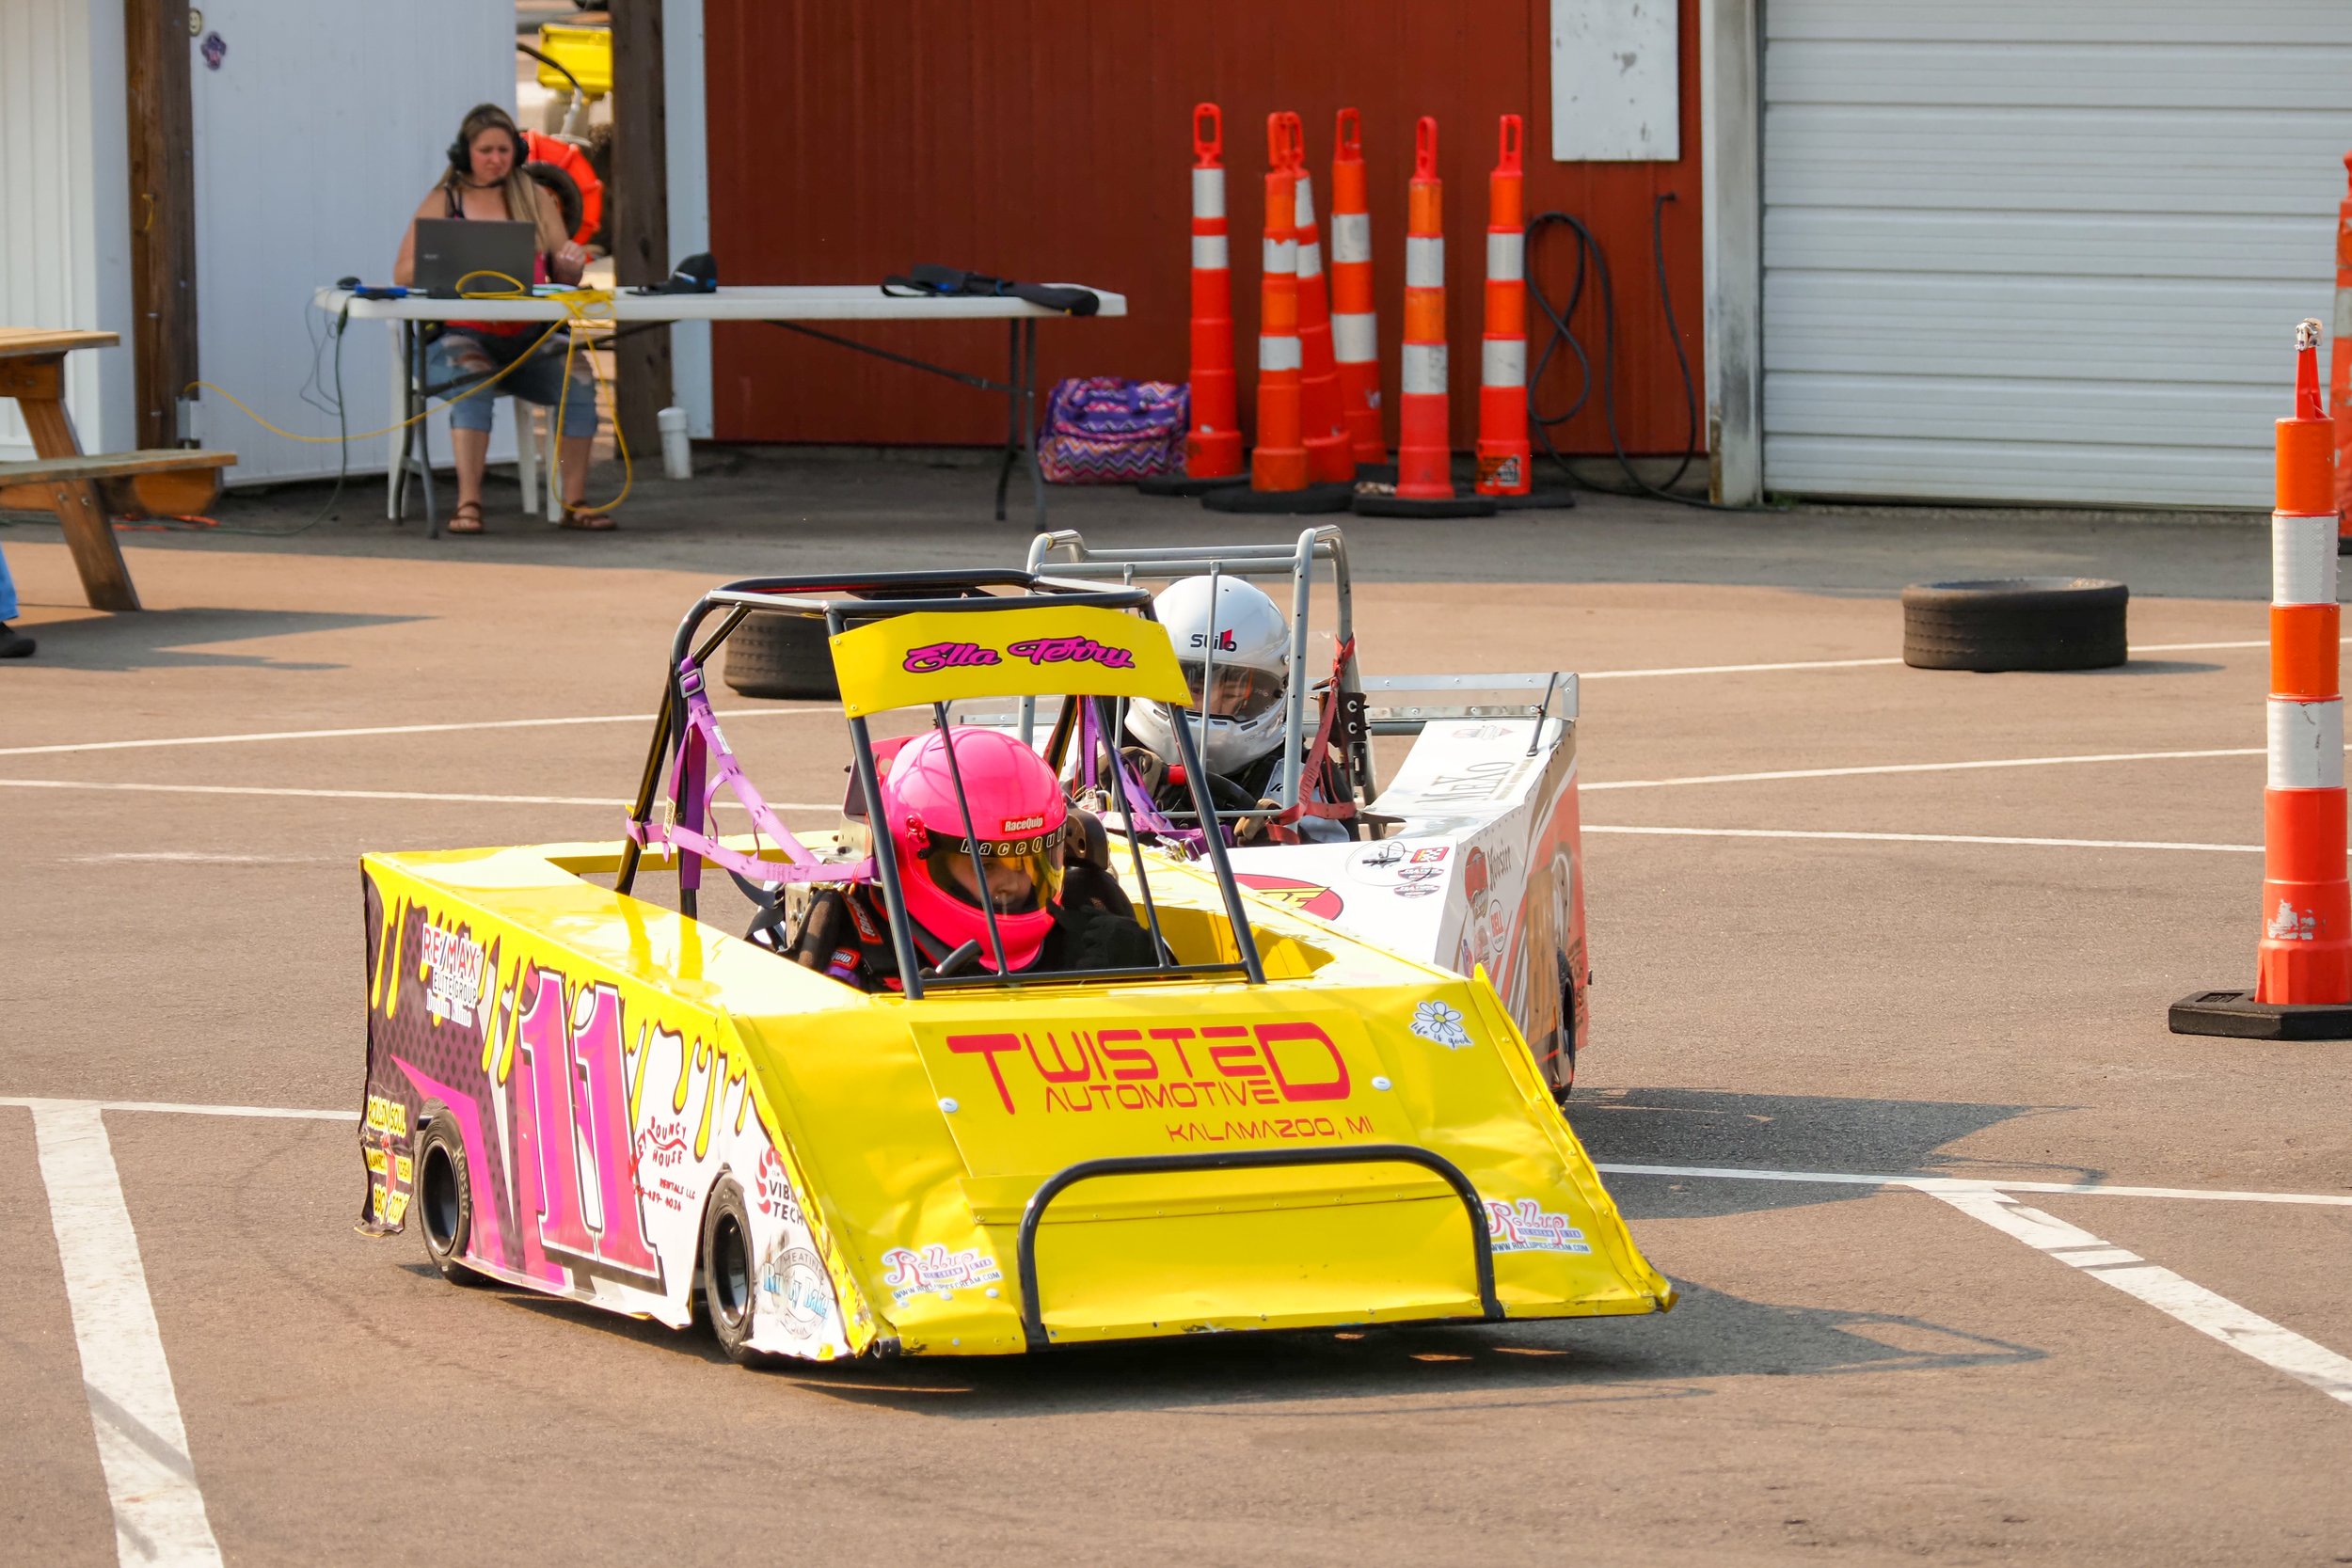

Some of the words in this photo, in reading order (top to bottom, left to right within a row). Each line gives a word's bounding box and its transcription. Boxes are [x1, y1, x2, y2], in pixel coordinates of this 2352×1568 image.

[902, 641, 1003, 673] Ella
[1007, 635, 1136, 669] Terry
[1004, 816, 1043, 832] RaceQuip
[423, 927, 478, 979] RE/MAX
[433, 971, 453, 997] ELITE
[454, 980, 477, 1005] GROUP
[946, 1022, 1351, 1115] TWISTED
[1045, 1079, 1279, 1114] AUTOMOTIVE
[518, 969, 661, 1282] 11
[651, 1116, 687, 1140] BOUNCY
[1166, 1117, 1343, 1143] KALAMAZOO,
[1345, 1116, 1374, 1134] MI
[652, 1148, 683, 1167] HOUSE
[773, 1201, 804, 1227] TECH
